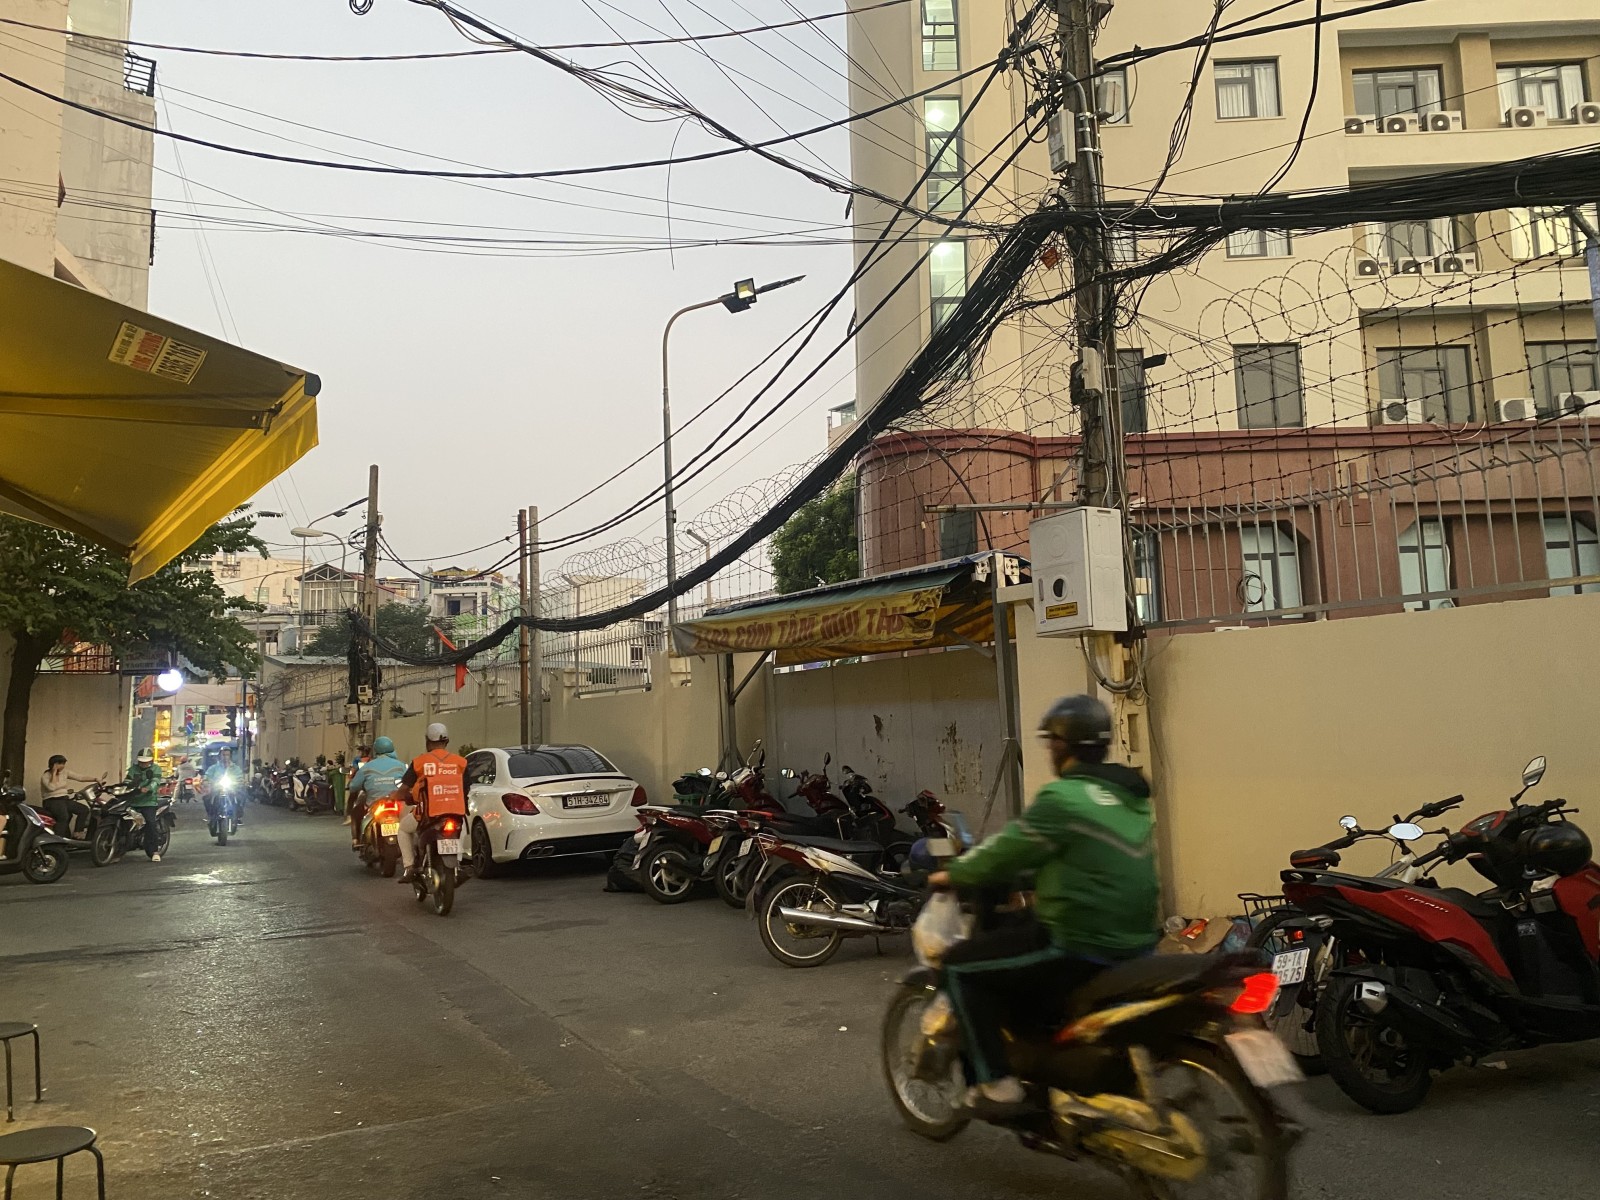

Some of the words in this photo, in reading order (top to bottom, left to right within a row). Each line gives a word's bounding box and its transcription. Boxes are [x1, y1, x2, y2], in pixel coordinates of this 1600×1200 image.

[734, 621, 772, 648] CƠM
[778, 609, 816, 644] TẤM
[438, 767, 457, 775] Food
